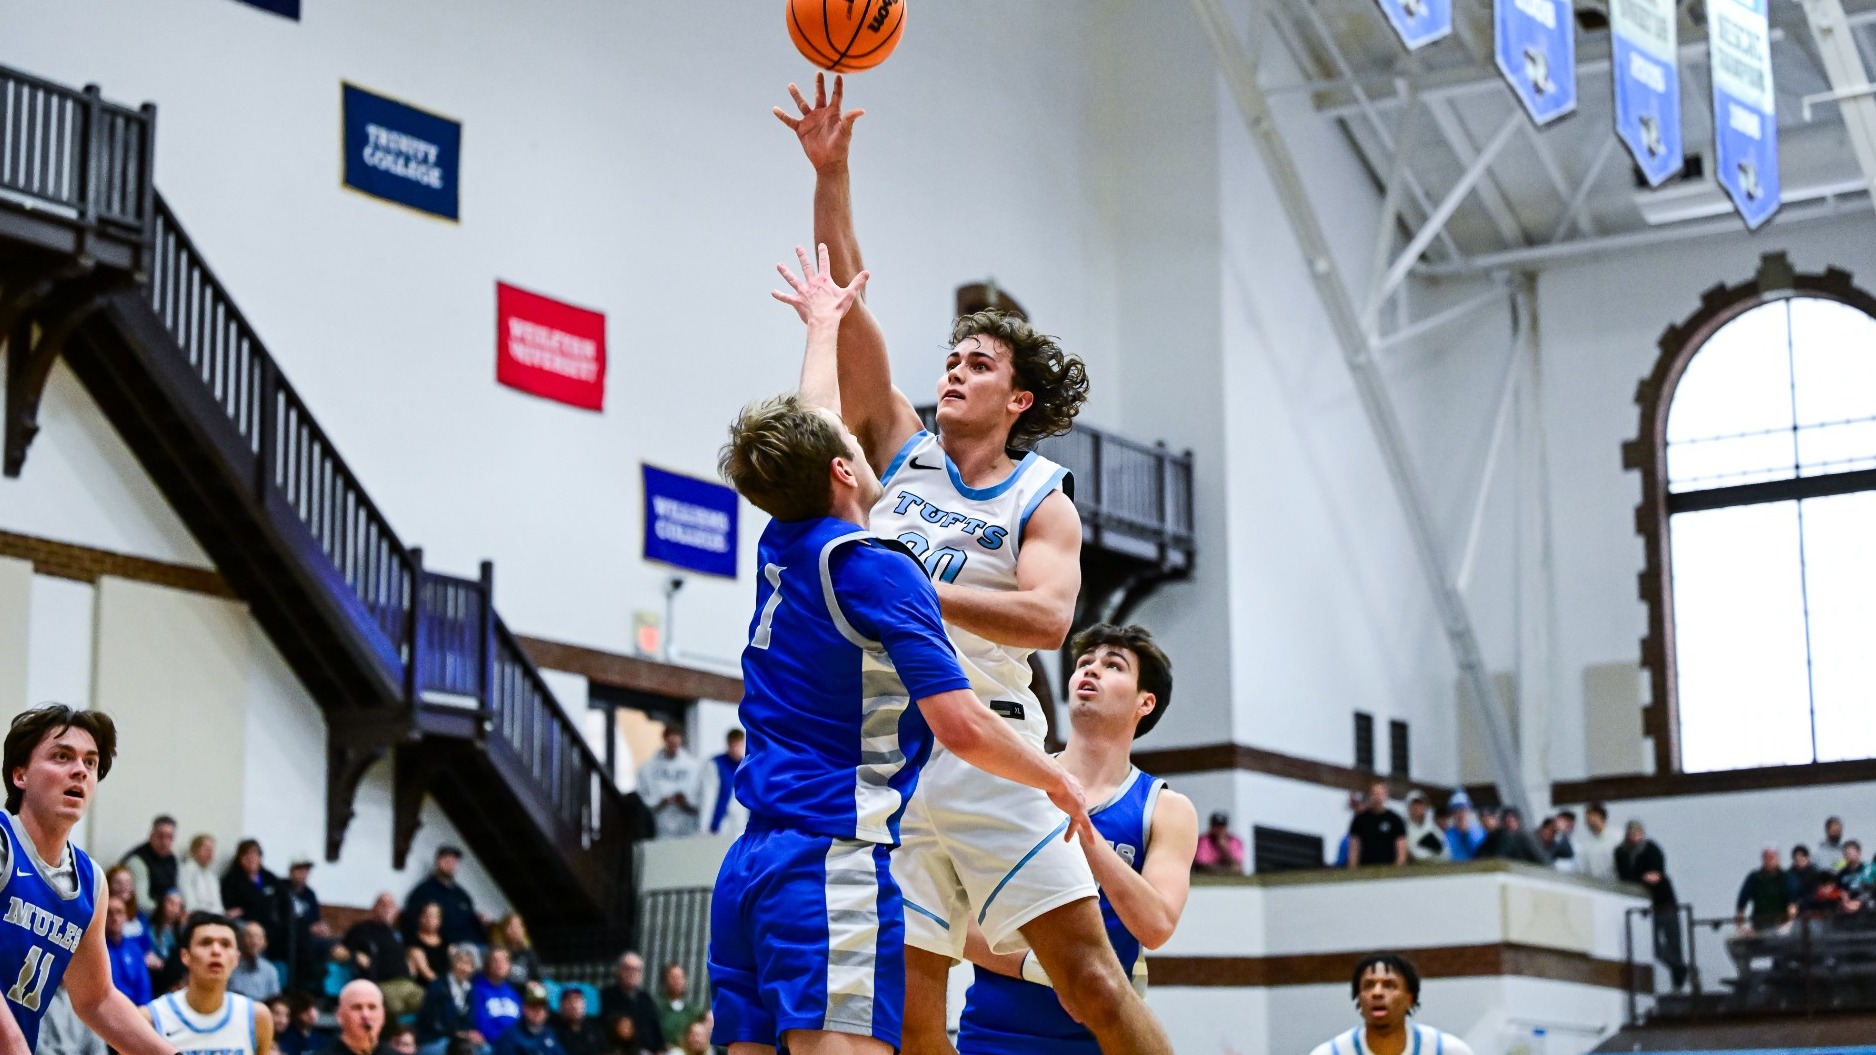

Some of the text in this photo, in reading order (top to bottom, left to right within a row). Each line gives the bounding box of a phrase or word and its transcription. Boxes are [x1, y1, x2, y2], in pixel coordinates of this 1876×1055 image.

[363, 145, 444, 189] COLLEGE
[893, 491, 1009, 550] TUFTS
[6, 944, 55, 1012] 11
